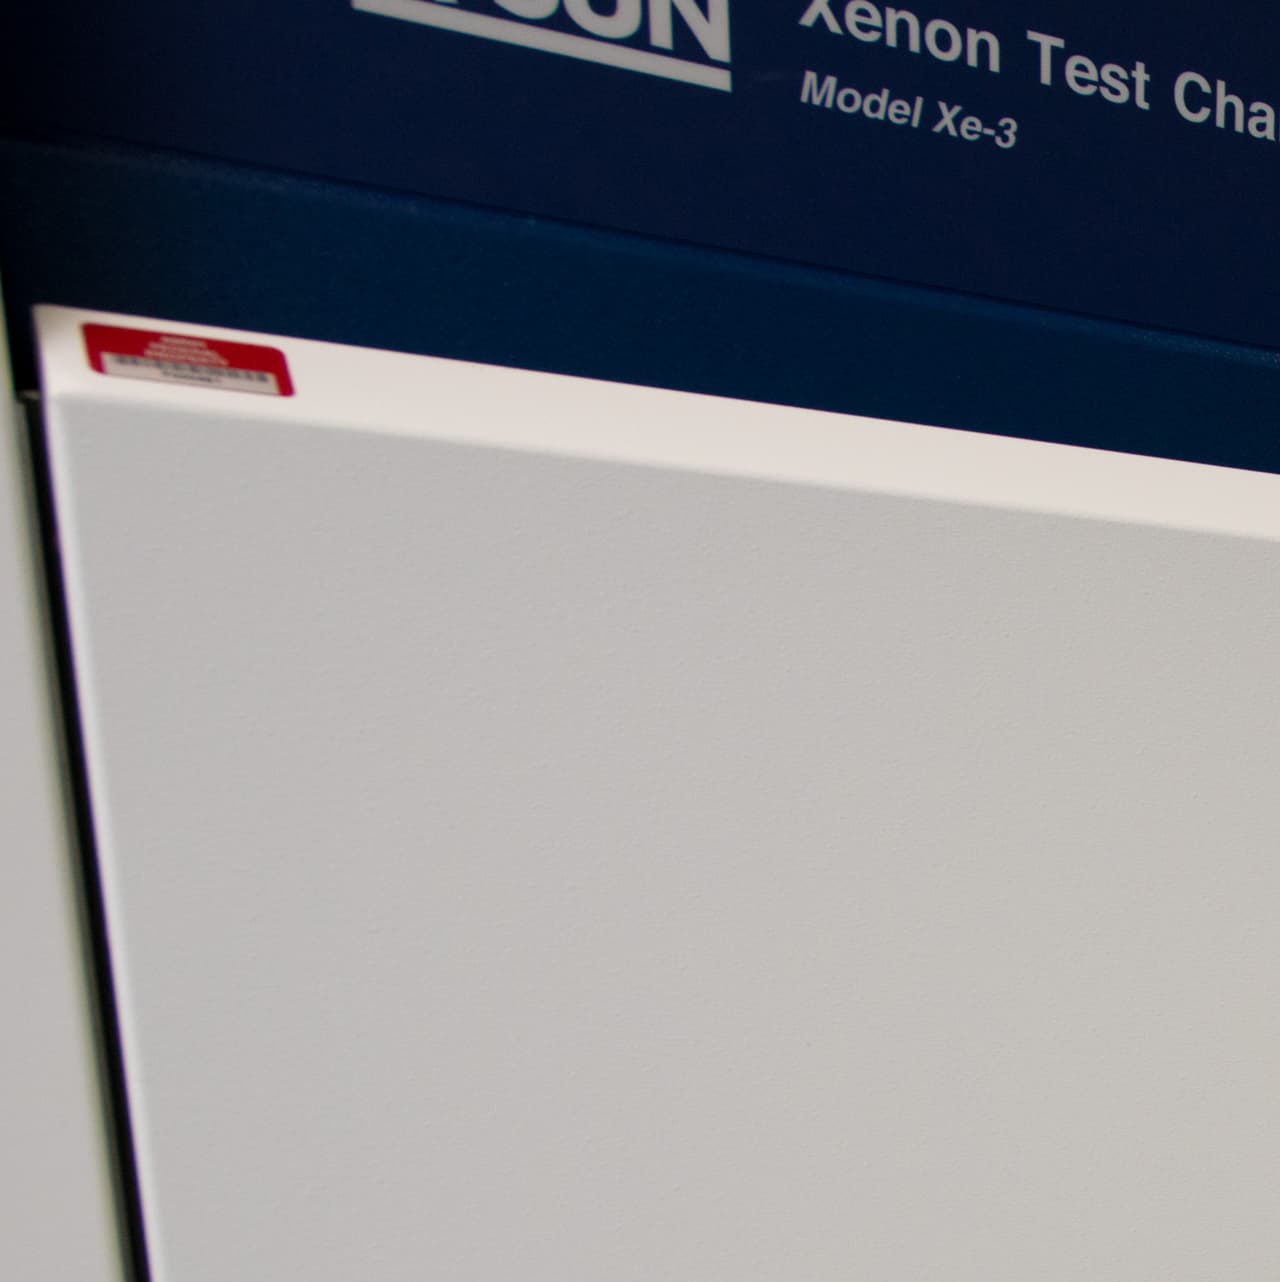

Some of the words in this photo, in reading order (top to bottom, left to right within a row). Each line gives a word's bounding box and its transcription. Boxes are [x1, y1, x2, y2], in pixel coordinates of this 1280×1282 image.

[798, 0, 1001, 74] Xenon
[1026, 30, 1151, 110] Test
[799, 69, 924, 129] Model
[931, 100, 1019, 149] Xe-3
